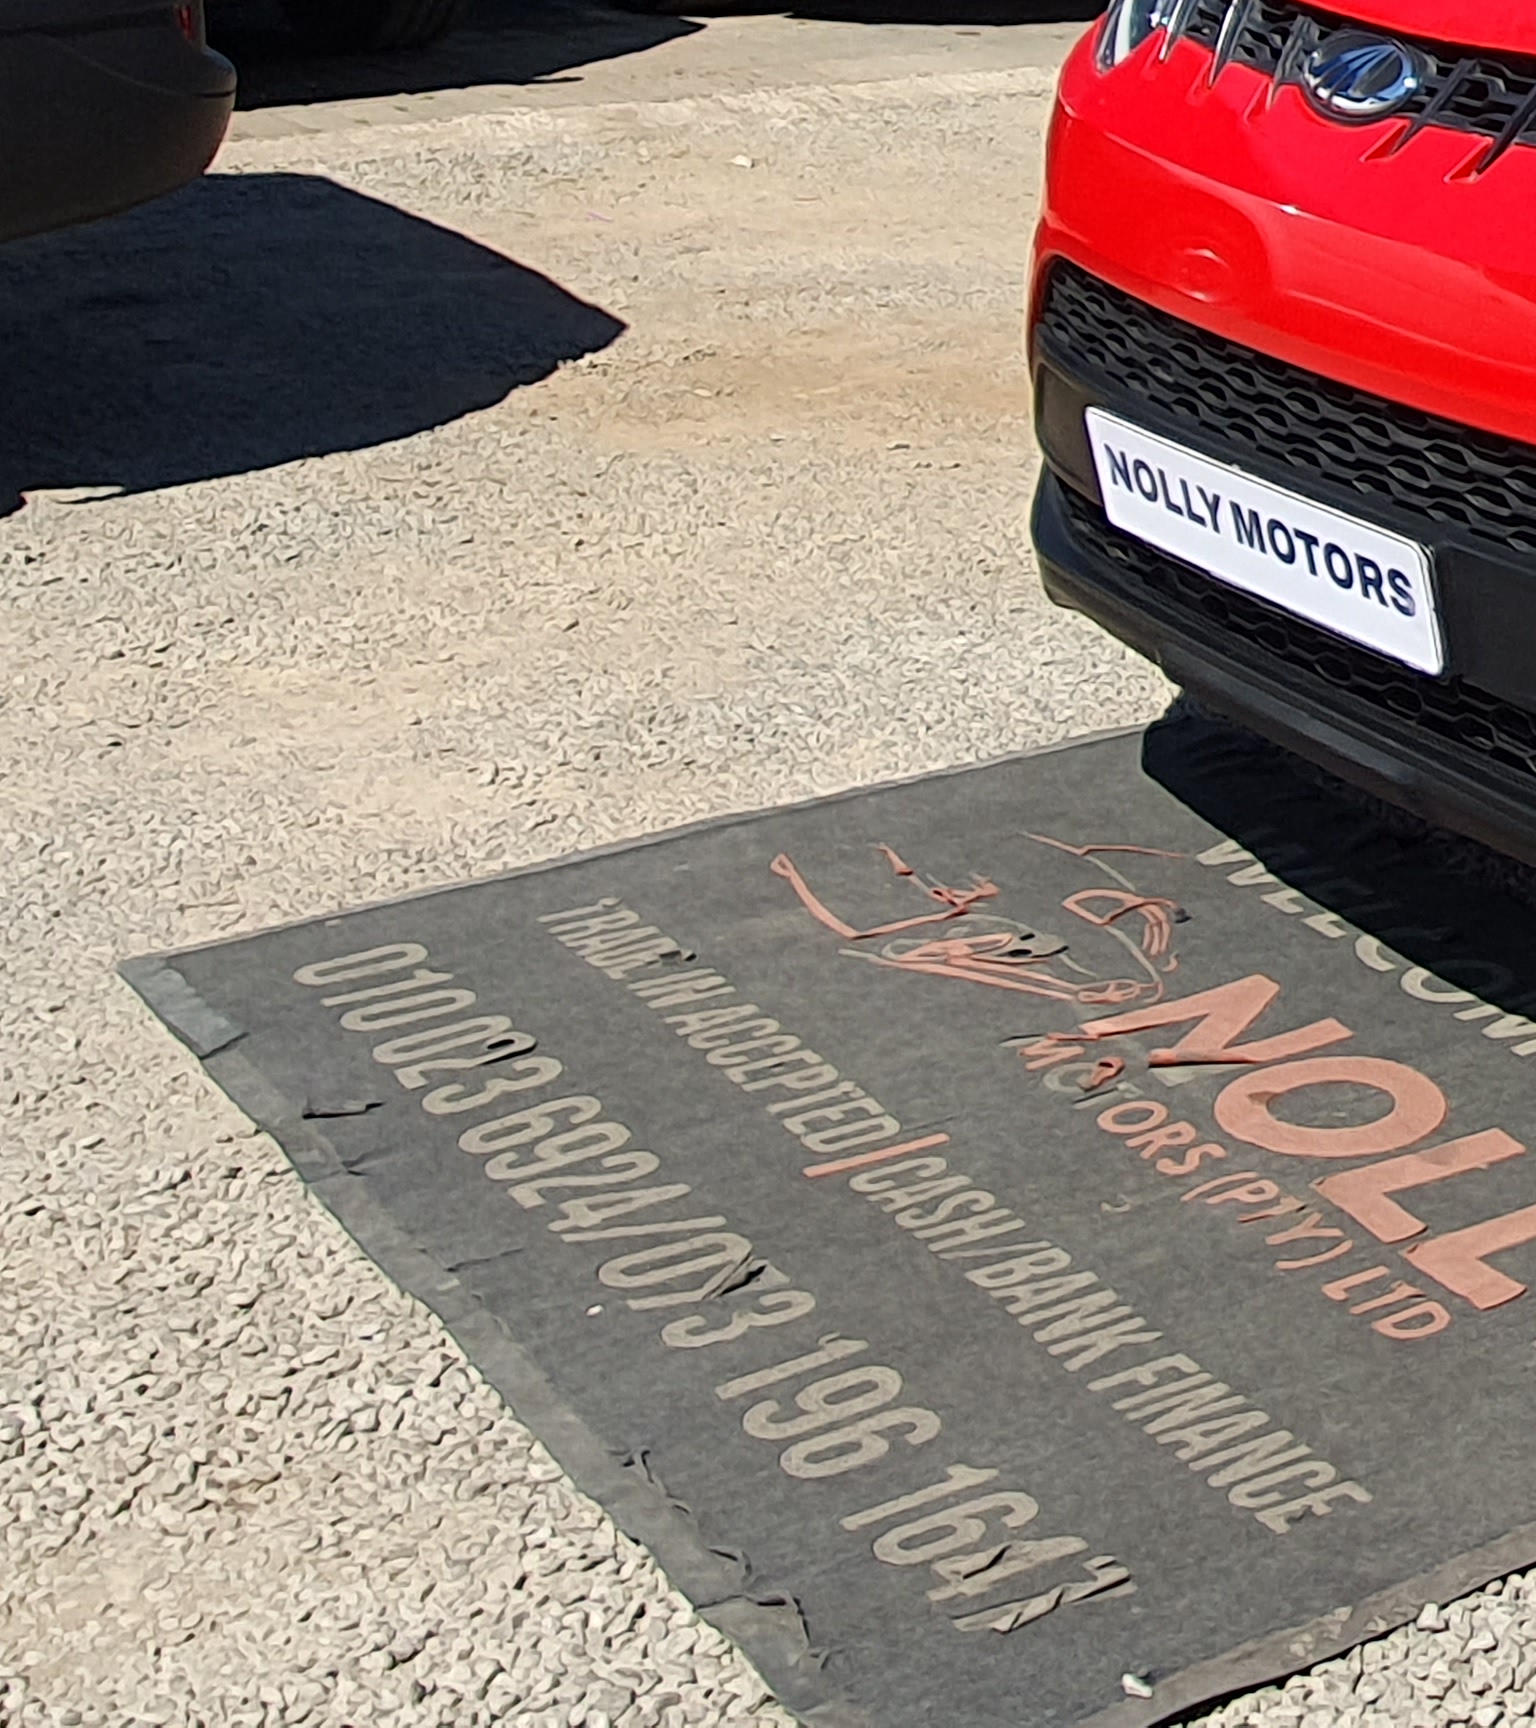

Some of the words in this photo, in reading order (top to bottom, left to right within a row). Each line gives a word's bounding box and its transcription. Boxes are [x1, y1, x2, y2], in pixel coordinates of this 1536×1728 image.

[1103, 442, 1222, 535] NOLLY
[1229, 500, 1417, 618] MOTORS
[293, 942, 478, 1032] 010
[371, 1014, 564, 1116] 023
[627, 967, 737, 1010] IN
[1086, 1353, 1374, 1535] FINANCE
[1180, 1171, 1353, 1271] (PTY)
[1321, 1265, 1452, 1340] LTD
[714, 1332, 943, 1480] 196
